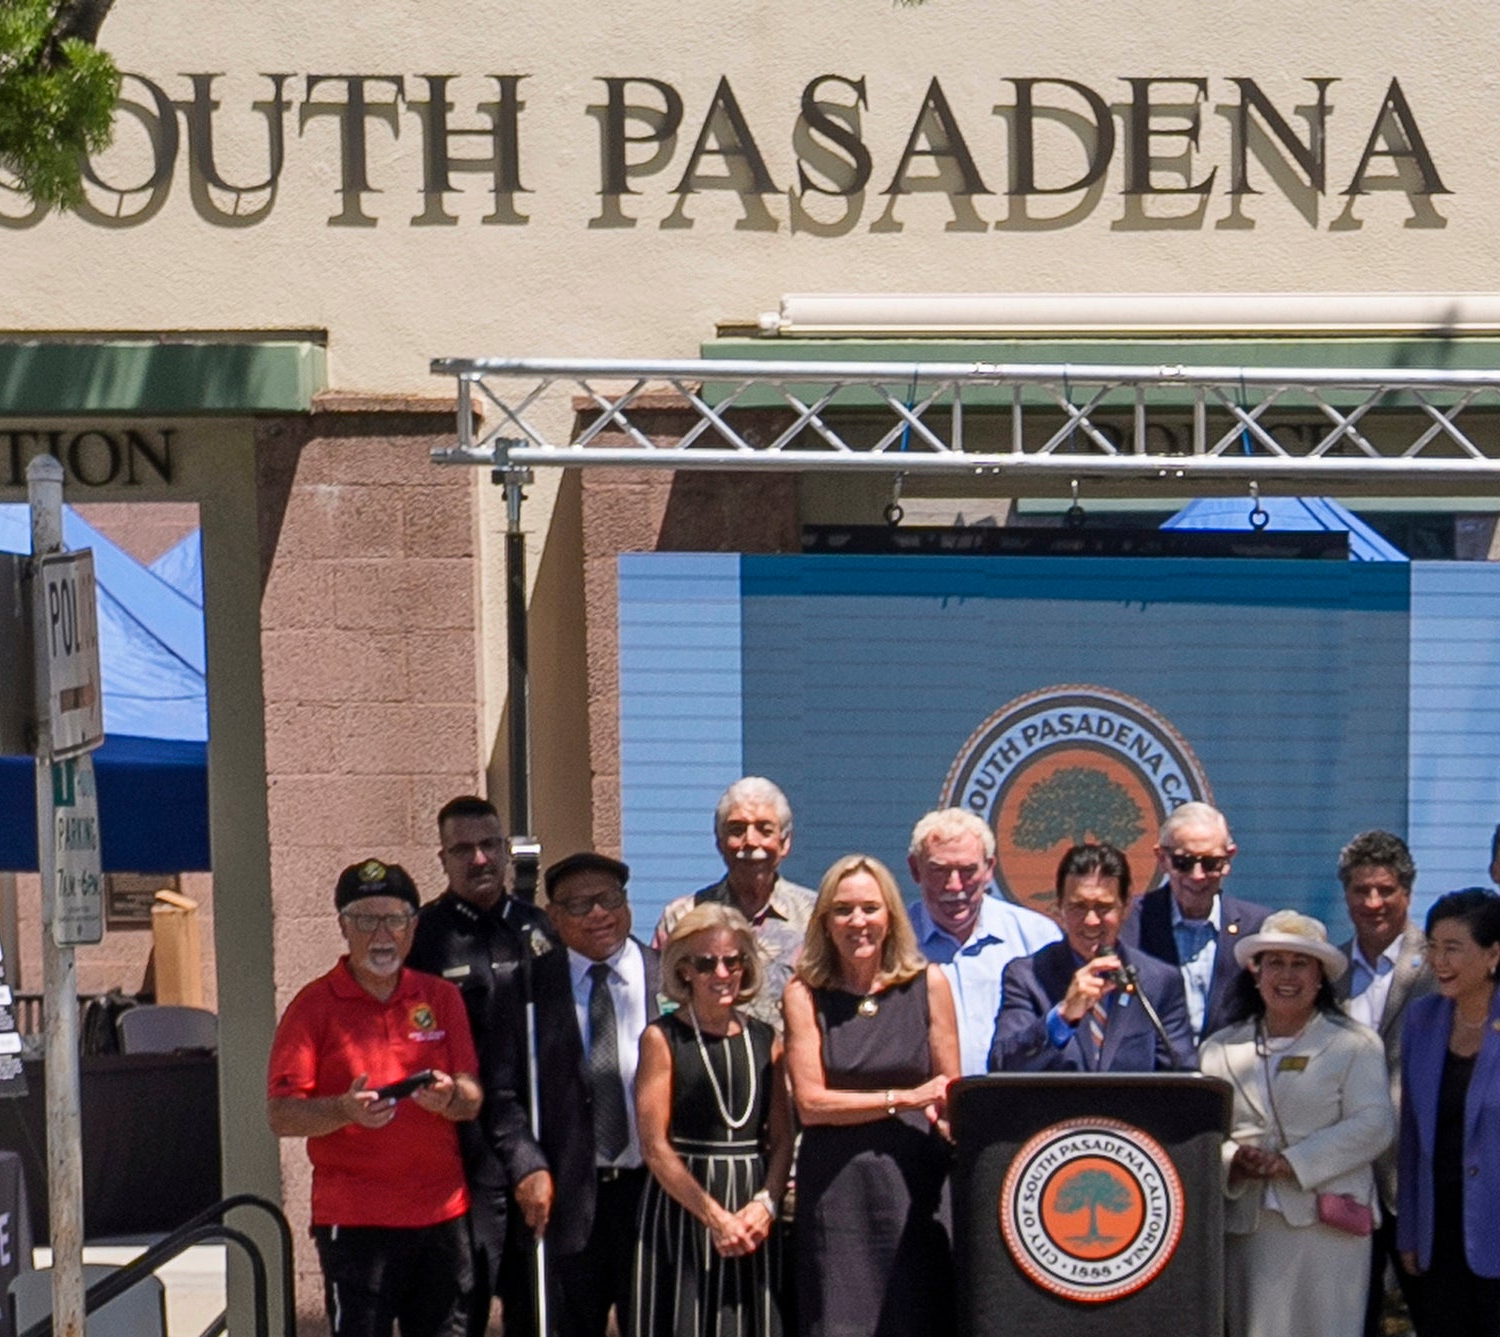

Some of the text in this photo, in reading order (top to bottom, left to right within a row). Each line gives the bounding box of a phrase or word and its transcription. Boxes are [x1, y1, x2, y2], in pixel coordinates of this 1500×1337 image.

[592, 74, 1457, 197] PASADENA
[968, 712, 1166, 820] OUTH PASADENA
[1023, 1154, 1059, 1203] SOUTH
[1058, 1138, 1145, 1173] PASADENA
[1121, 1172, 1164, 1267] CALIFORNIA
[1028, 1232, 1059, 1267] CITY
[1069, 1263, 1112, 1280] 1888
